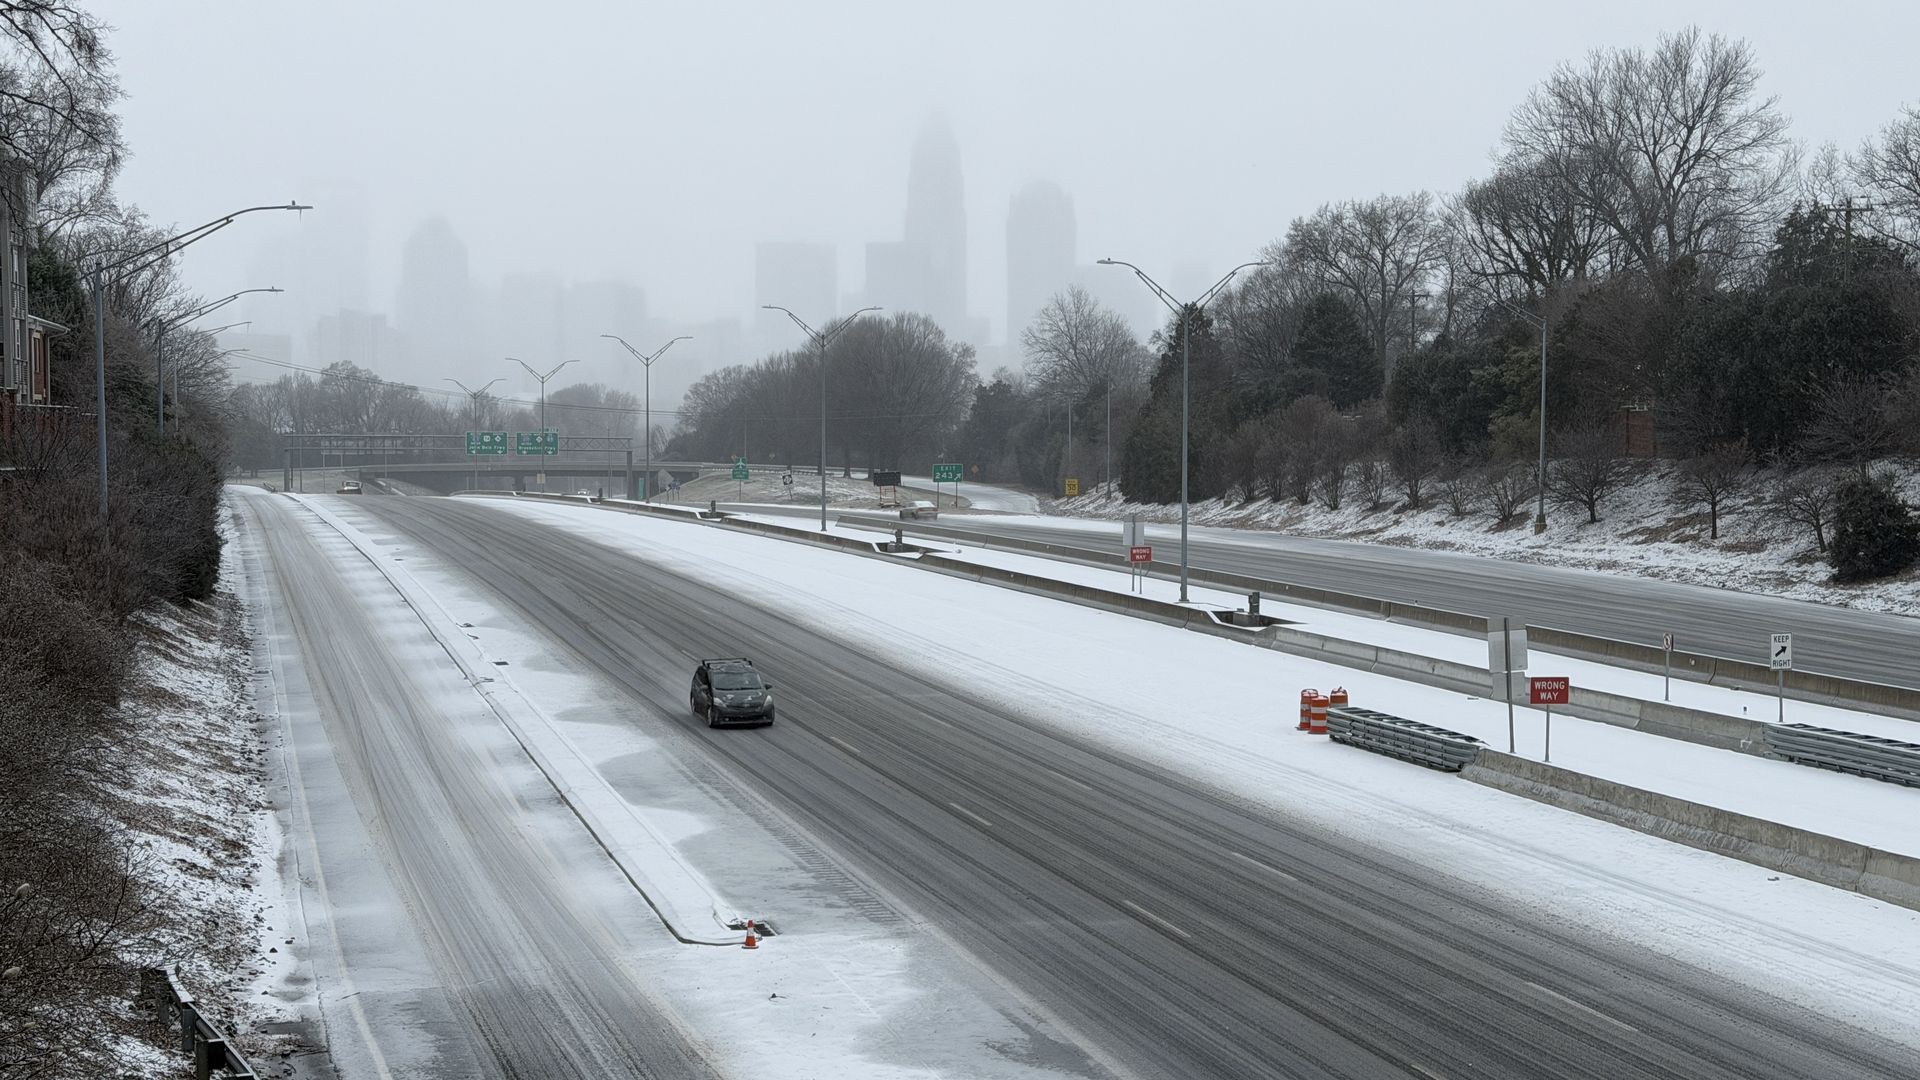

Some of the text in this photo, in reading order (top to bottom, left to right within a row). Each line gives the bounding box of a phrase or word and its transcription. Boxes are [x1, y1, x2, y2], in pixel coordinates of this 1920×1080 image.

[1773, 635, 1790, 643] KEEP
[1772, 660, 1791, 668] RIGHT
[1534, 681, 1566, 690] WRONG
[1540, 691, 1559, 701] WAY
